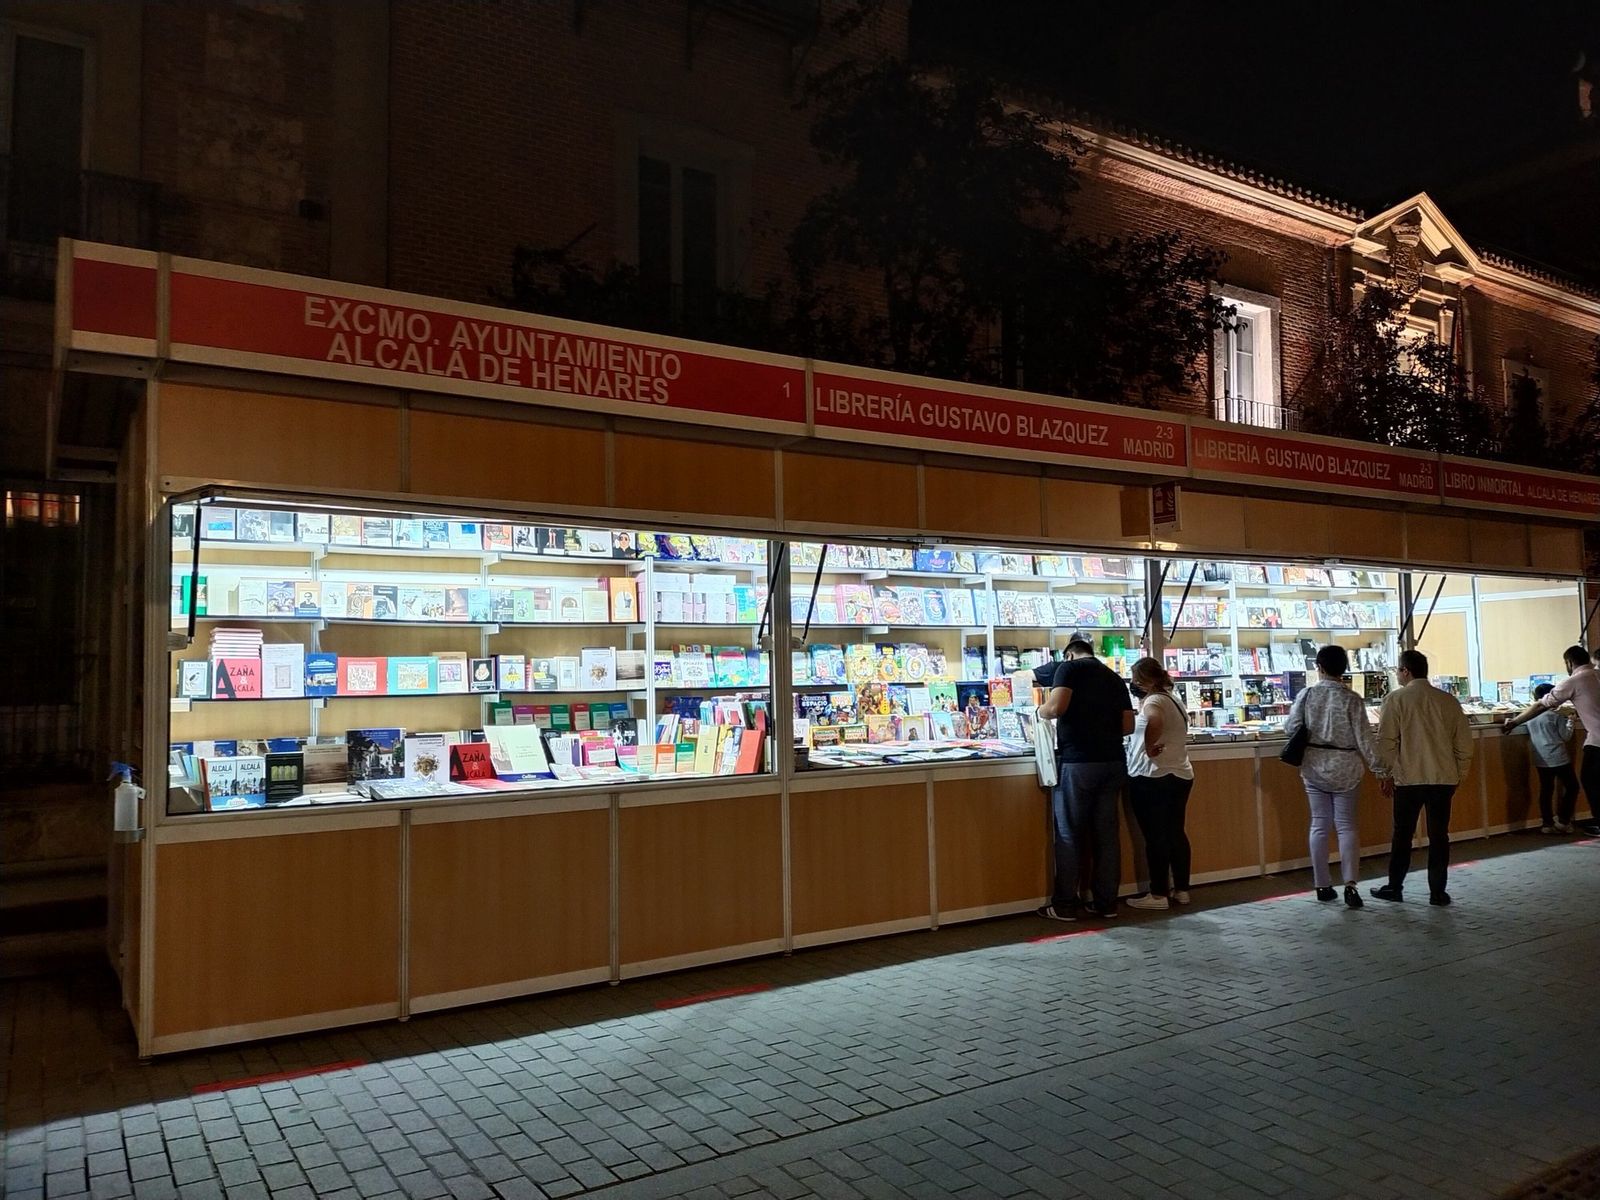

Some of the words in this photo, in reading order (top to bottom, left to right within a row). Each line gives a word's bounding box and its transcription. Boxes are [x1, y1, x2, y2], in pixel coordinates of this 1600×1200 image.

[304, 295, 440, 345] EXCMO.
[449, 320, 681, 380] AYUNTAMIENTO
[326, 332, 468, 379] ALCALÁ
[479, 353, 520, 386] DE
[532, 360, 669, 404] HENARES
[782, 381, 791, 398] 1
[815, 386, 916, 424] LIBRERÍA
[919, 402, 1011, 436] GUSTAVO
[1016, 414, 1109, 447] BLAZQUEZ
[1155, 424, 1174, 440] 2-3
[1123, 437, 1175, 459] MADRID
[1194, 438, 1261, 465] LIBRERÍA
[1265, 446, 1325, 473] GUSTAVO
[1328, 455, 1391, 481] BLAZQUEZ
[1399, 471, 1434, 490] MADRID
[1420, 462, 1432, 475] 2-3
[1444, 471, 1475, 491] LIBRO
[1477, 476, 1525, 497] INMORTAL
